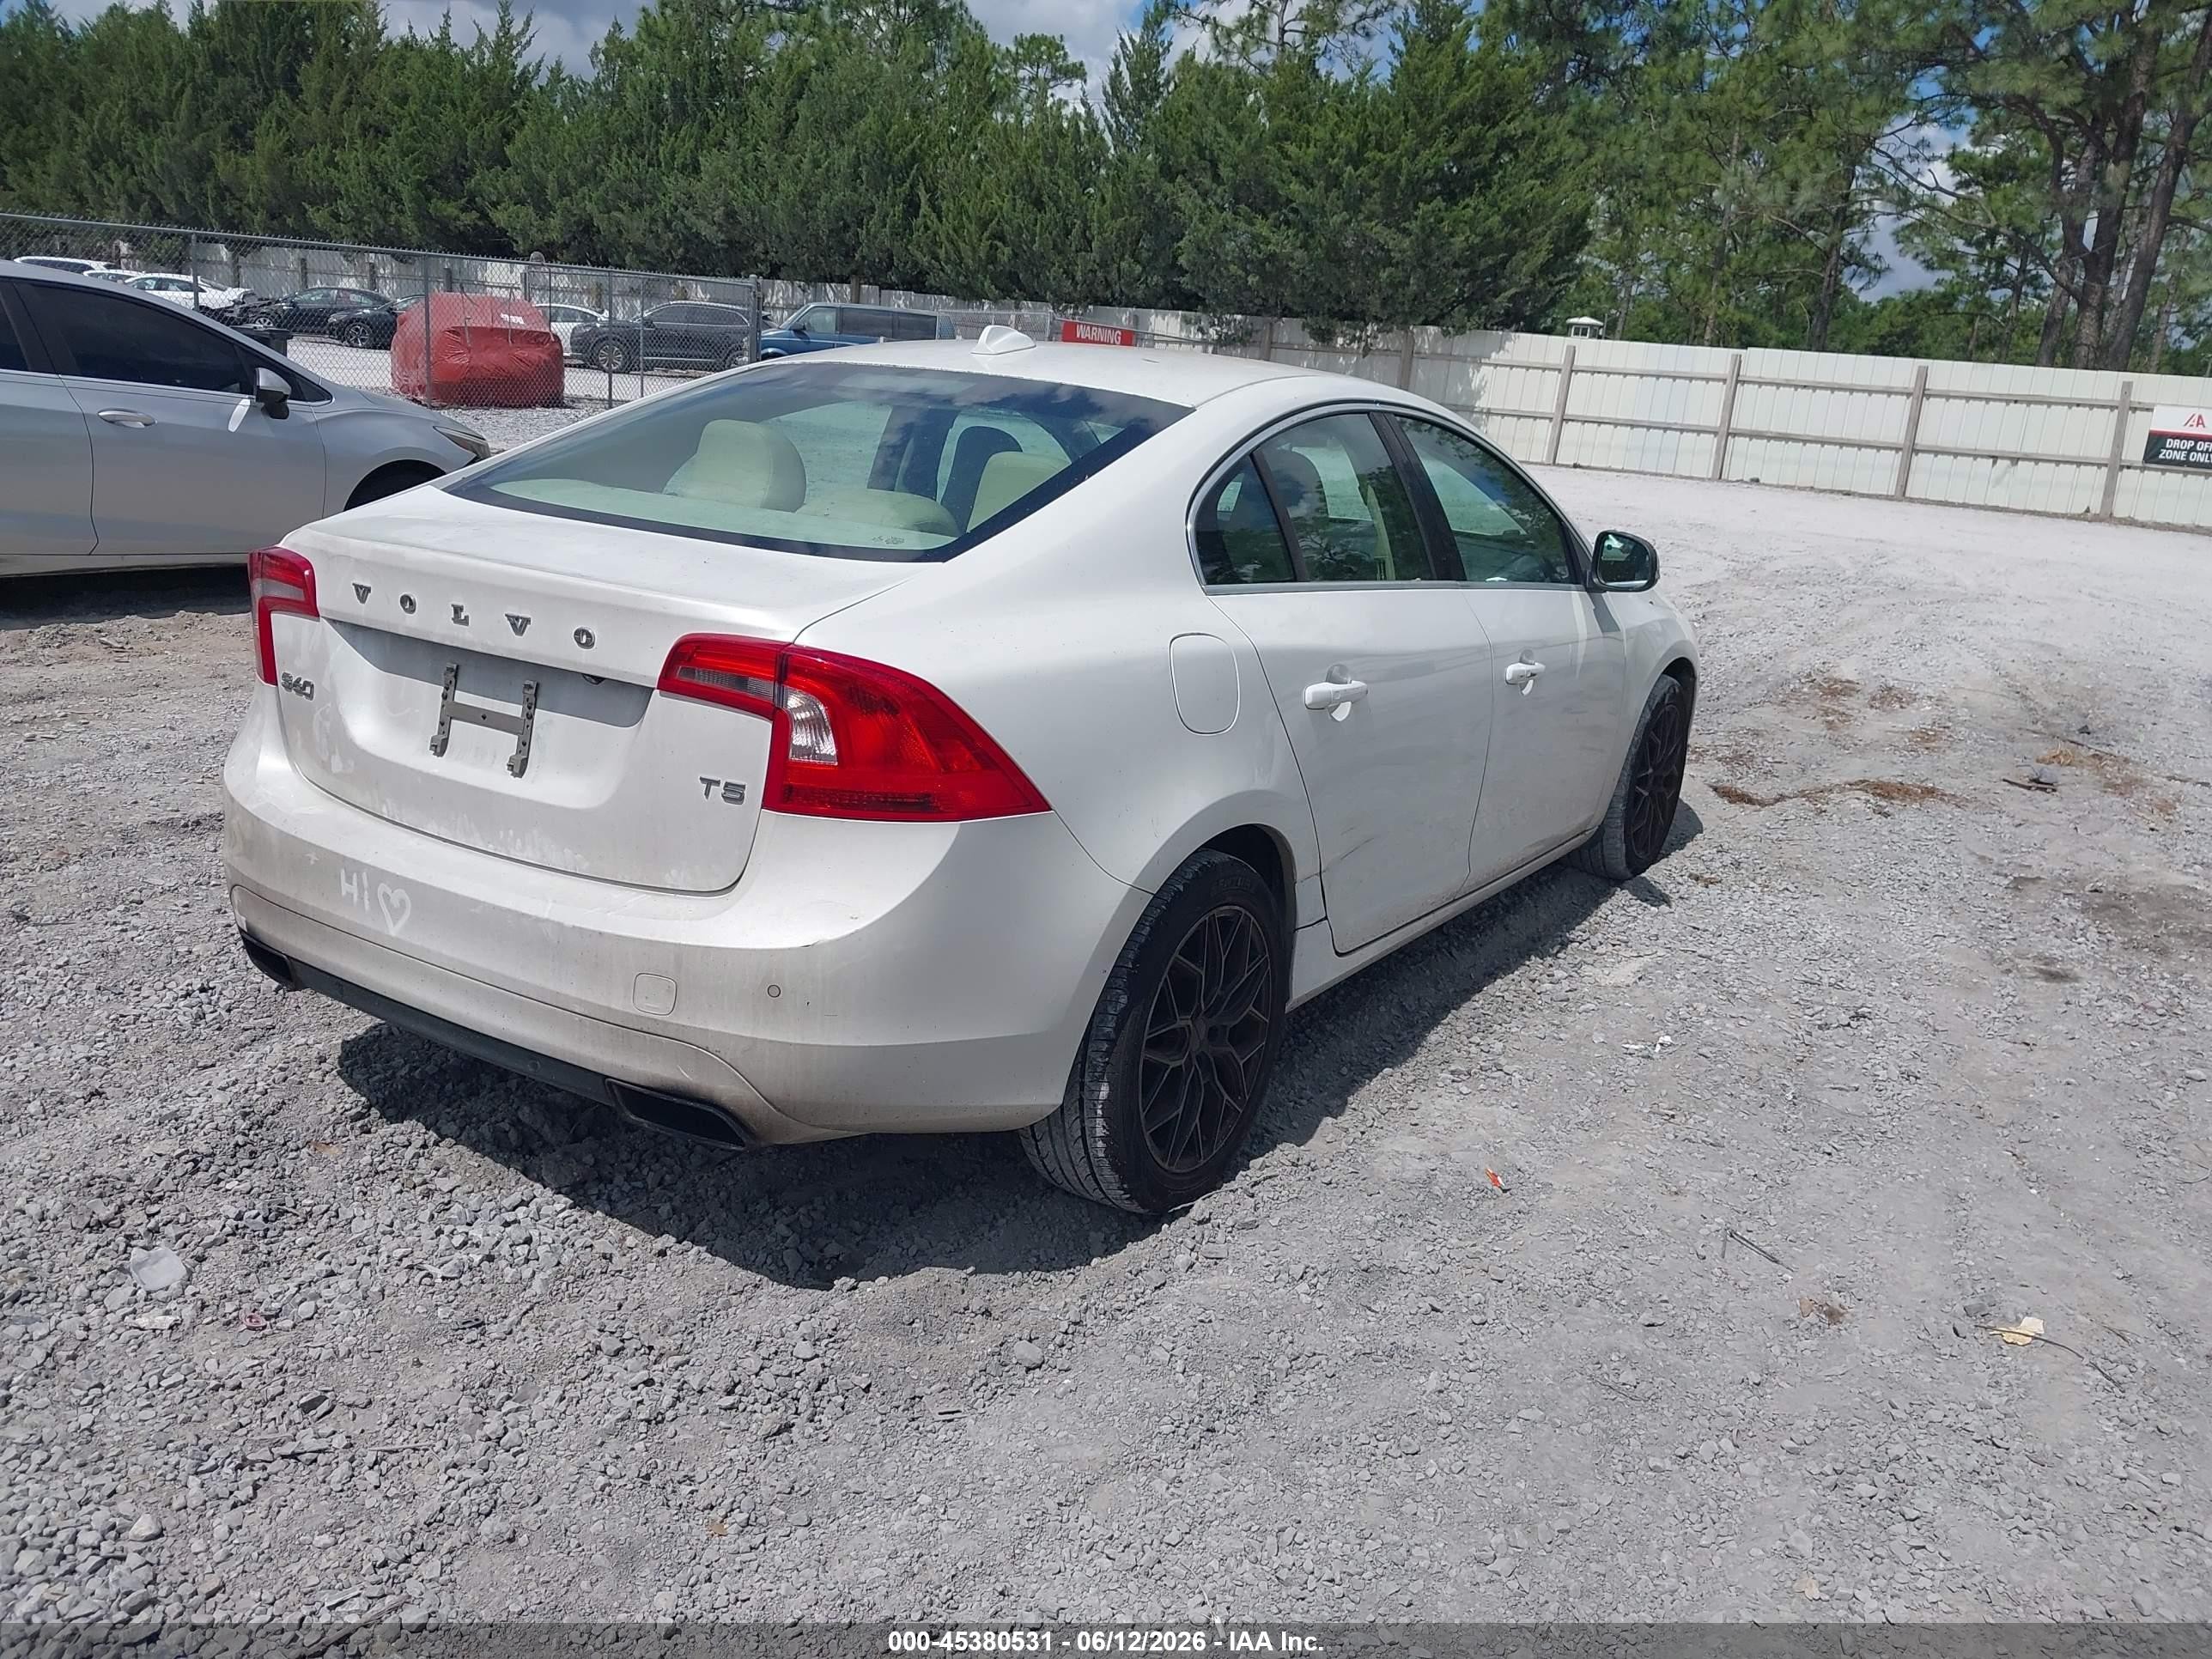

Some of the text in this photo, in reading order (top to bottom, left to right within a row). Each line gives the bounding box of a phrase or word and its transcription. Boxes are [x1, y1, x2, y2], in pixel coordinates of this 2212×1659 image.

[1076, 324, 1121, 345] WARNING
[2158, 448, 2187, 461] ZONE
[2166, 439, 2194, 451] DROP
[351, 582, 597, 650] VOLVO
[281, 672, 314, 702] S60
[699, 775, 746, 805] T5
